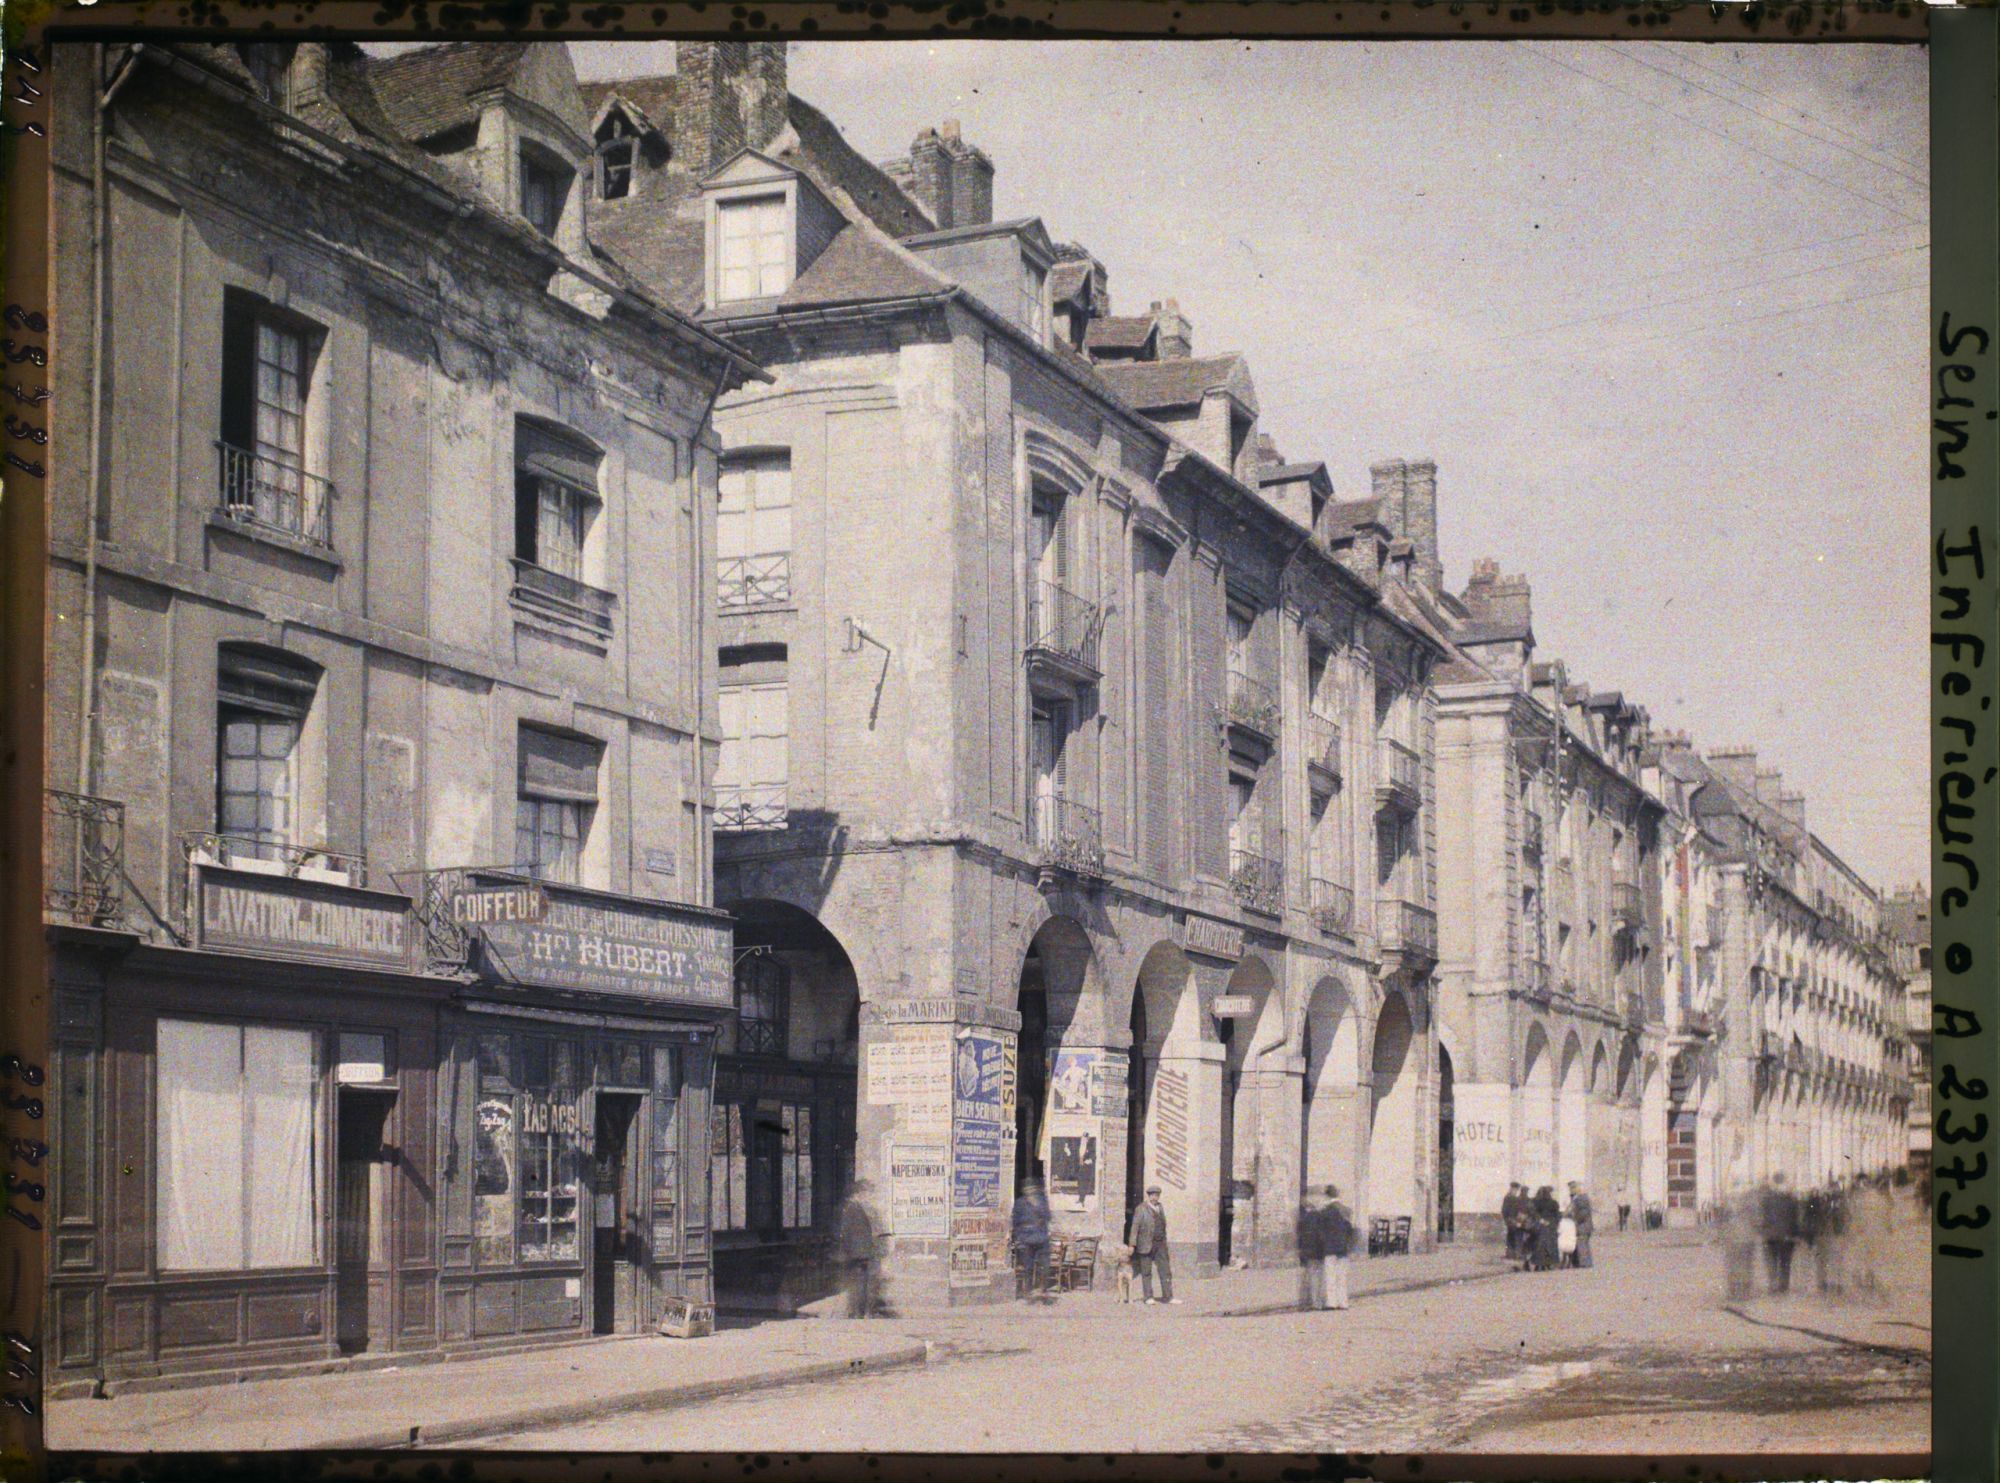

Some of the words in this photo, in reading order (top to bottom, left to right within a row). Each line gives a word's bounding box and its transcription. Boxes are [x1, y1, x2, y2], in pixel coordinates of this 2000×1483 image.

[1933, 311, 1997, 480] Seine
[204, 884, 300, 941] LAVATORY
[311, 900, 404, 955] COMMERCE
[454, 888, 540, 923] COIFFEUR
[578, 934, 686, 979] HUBERT
[1187, 915, 1243, 957] CHARCUTERIE
[908, 1001, 955, 1018] MARINE
[1934, 1004, 1982, 1038] A
[1002, 1035, 1017, 1106] SUZE
[522, 1090, 576, 1135] TABACS
[1156, 1063, 1189, 1192] CHARCUTERIE
[1455, 1121, 1504, 1144] HOTEL
[891, 1164, 946, 1178] NAPIERKOWSKA
[1935, 1064, 1991, 1259] 23731
